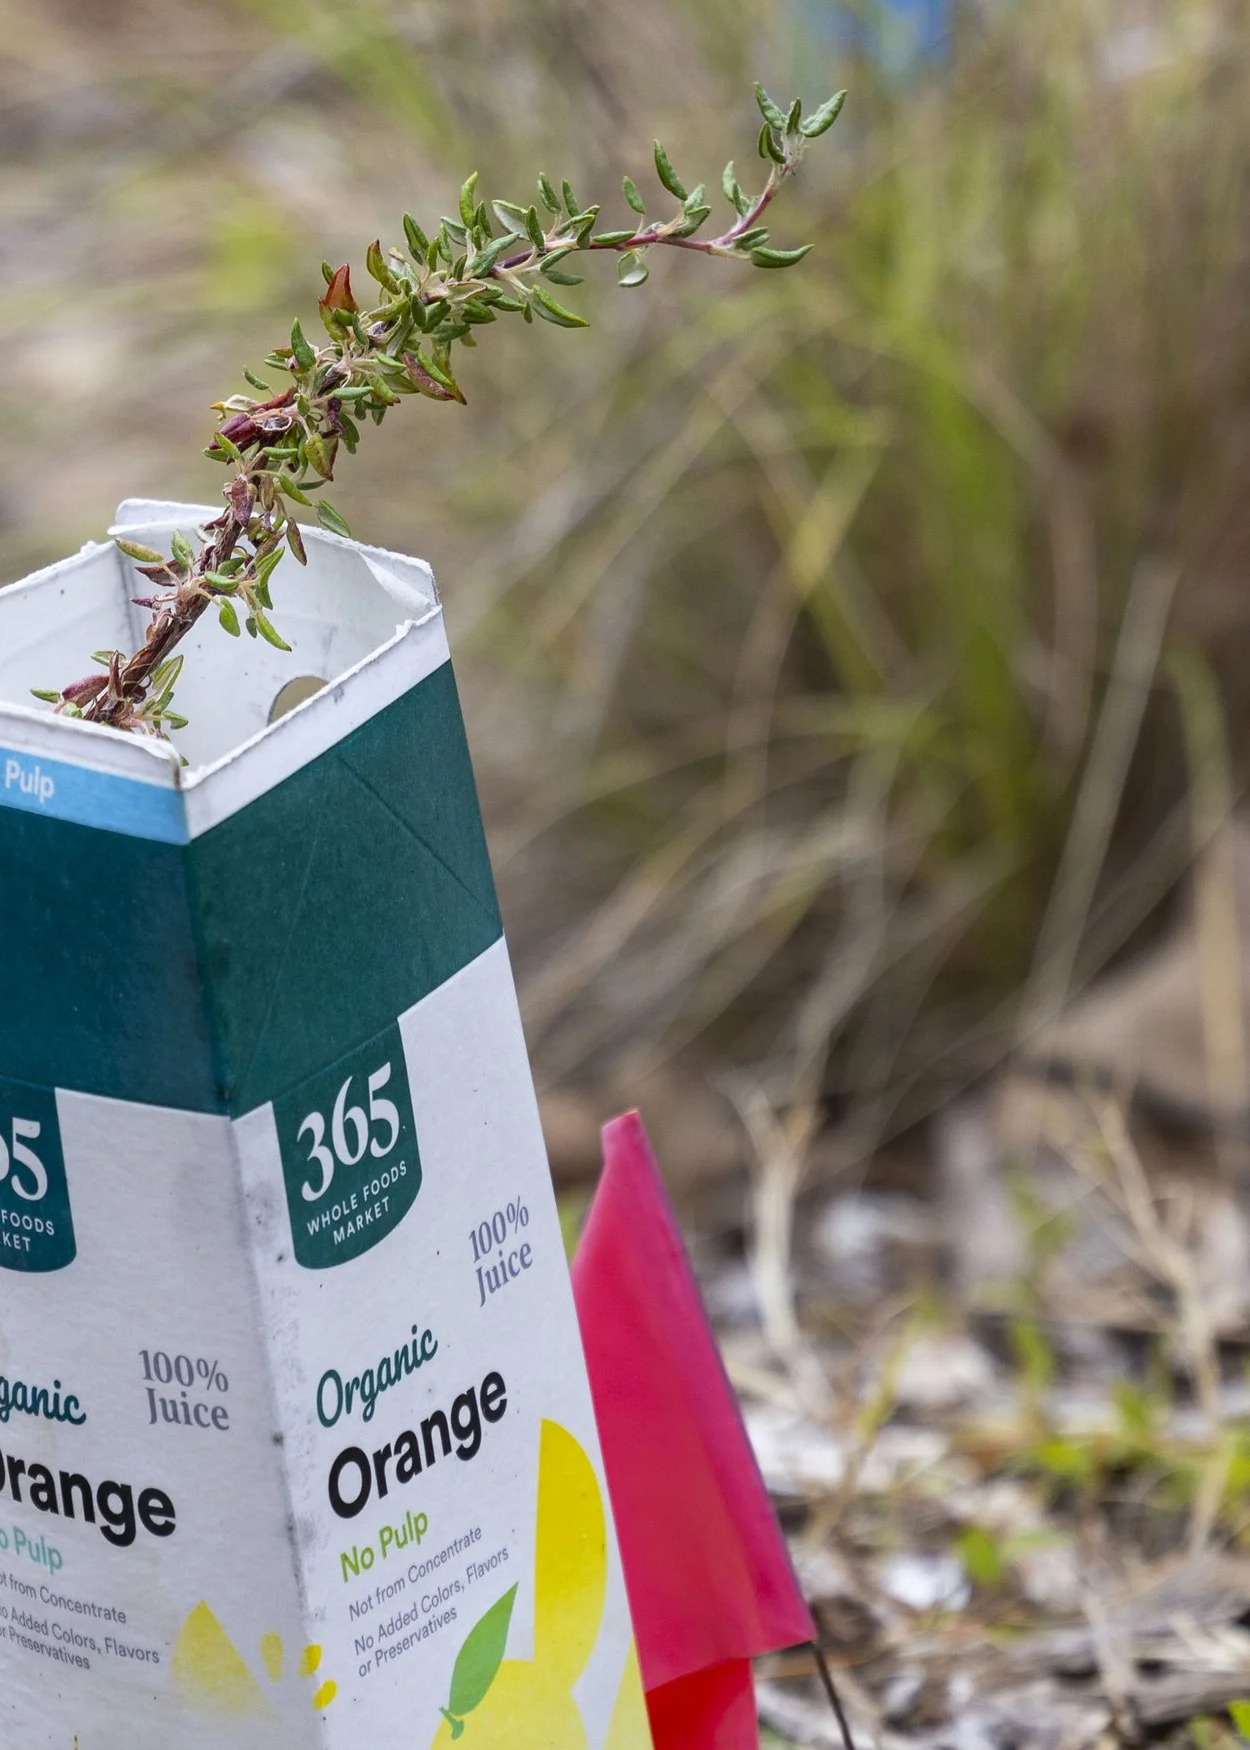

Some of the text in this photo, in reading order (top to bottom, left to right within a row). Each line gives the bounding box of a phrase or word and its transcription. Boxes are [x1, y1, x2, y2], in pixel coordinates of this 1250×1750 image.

[5, 759, 55, 803] Pulp
[297, 1061, 400, 1201] 365
[1, 1209, 55, 1236] FOODS
[306, 1160, 407, 1236] WHOLE FOODS
[333, 1196, 390, 1245] MARKET
[468, 1195, 530, 1263] 100%
[474, 1242, 533, 1306] Juice
[138, 1349, 229, 1393] 100%
[316, 1324, 438, 1428] Organic
[145, 1387, 230, 1431] Juice
[328, 1371, 507, 1519] Orange
[13, 1525, 63, 1575] Pulp
[340, 1510, 429, 1583] No Pulp
[349, 1525, 483, 1622] Not from Concentrate
[9, 1572, 37, 1600] from
[39, 1586, 127, 1624] Concentrate
[354, 1547, 510, 1656] No Added Colors, Flavors
[8, 1626, 91, 1670] Preservatives
[11, 1607, 49, 1636] Added
[51, 1625, 102, 1655] Colors,
[104, 1637, 160, 1664] Flavors
[358, 1605, 458, 1678] or Preservatives
